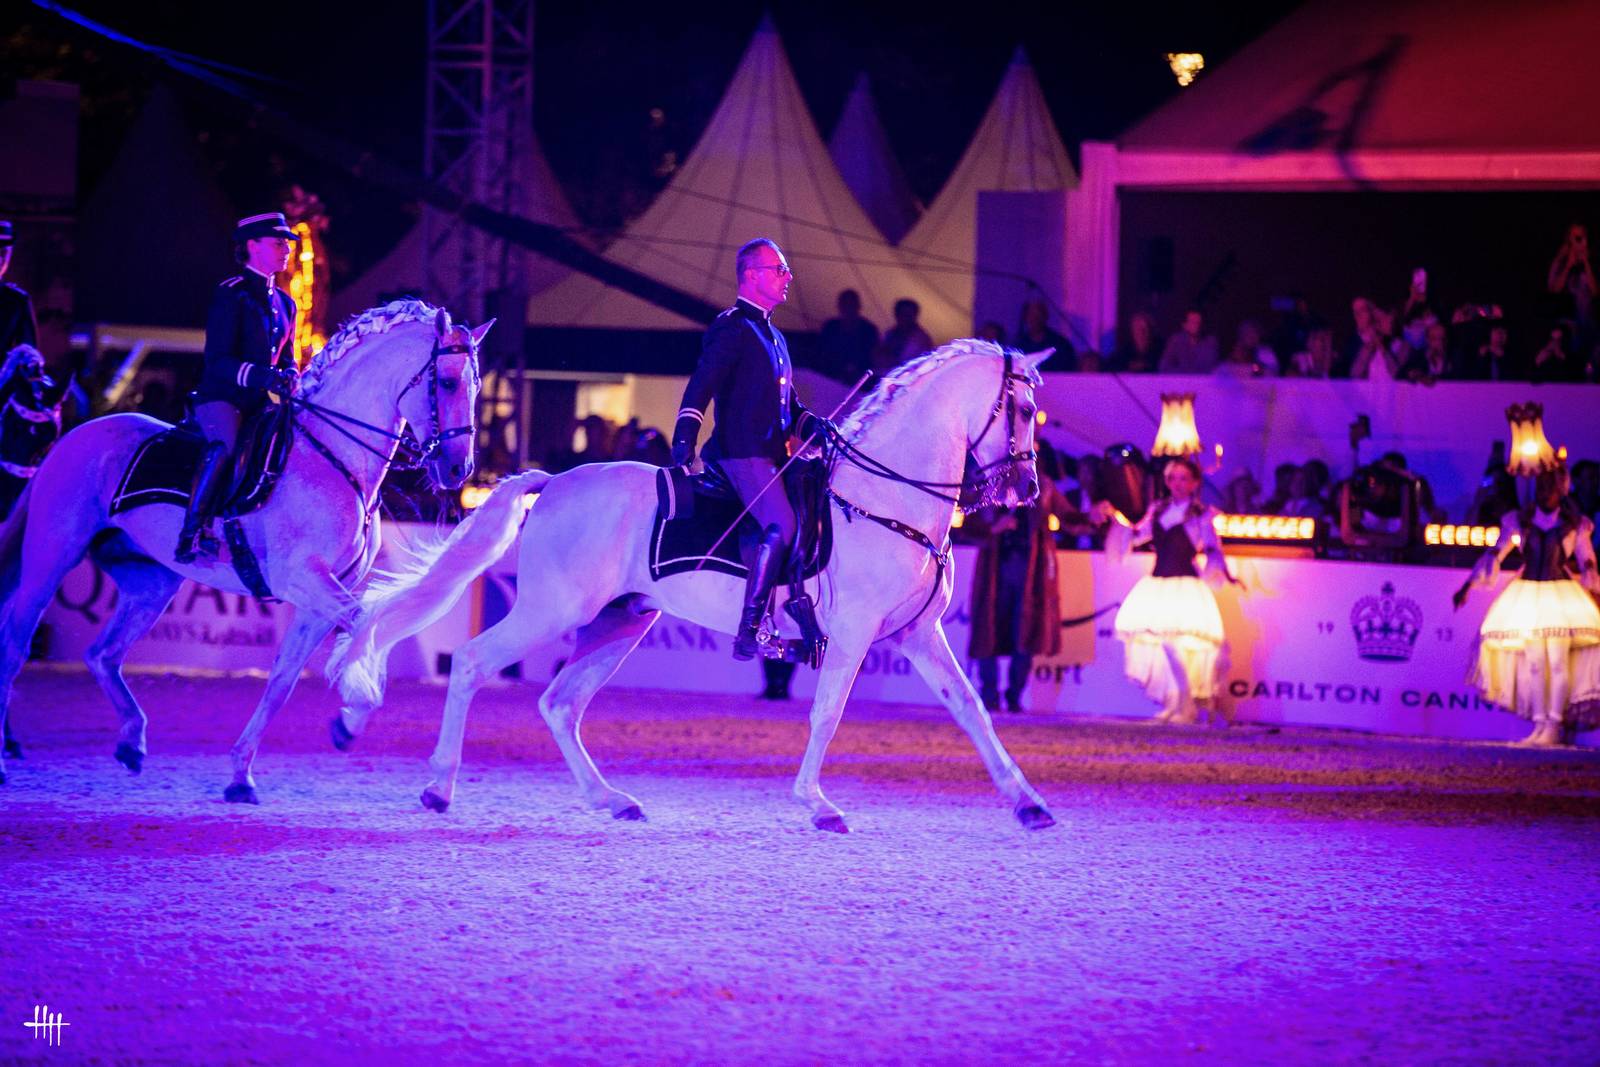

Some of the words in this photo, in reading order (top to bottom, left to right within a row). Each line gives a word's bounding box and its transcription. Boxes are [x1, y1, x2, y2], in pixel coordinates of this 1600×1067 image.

[1033, 662, 1083, 686] ort
[1228, 679, 1381, 705] CARLTON
[1400, 689, 1508, 712] CANN
